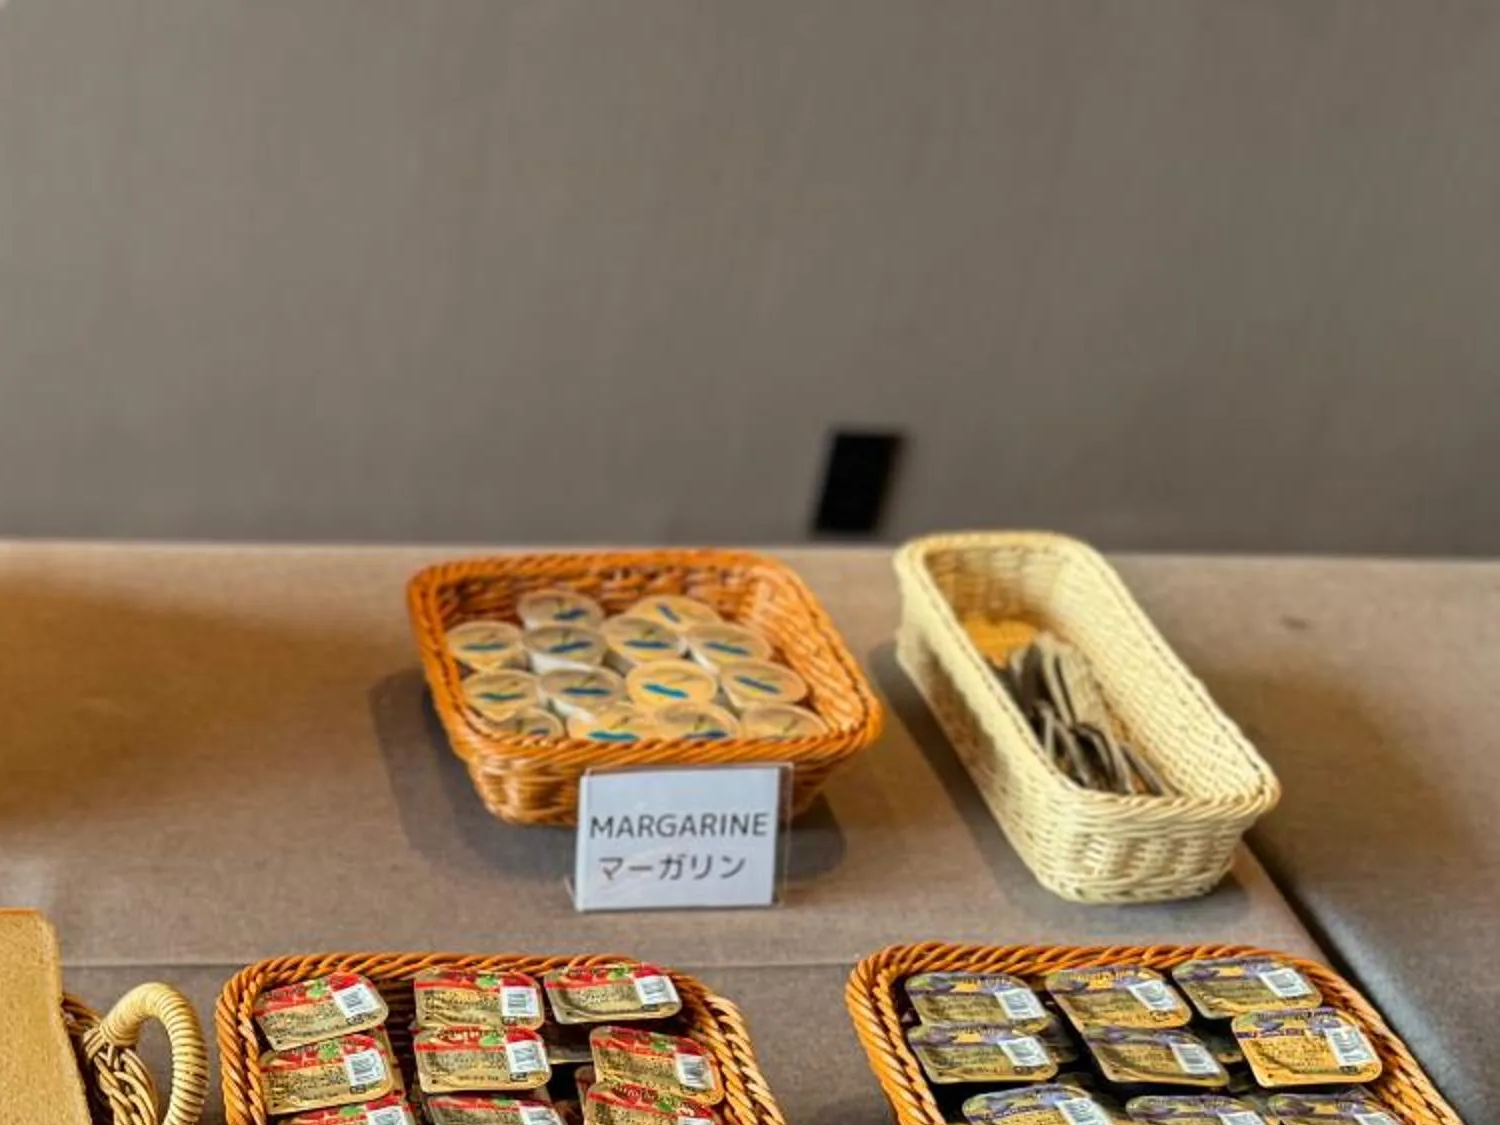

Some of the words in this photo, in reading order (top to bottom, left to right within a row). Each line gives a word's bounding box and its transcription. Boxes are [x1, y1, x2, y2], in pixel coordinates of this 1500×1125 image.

[589, 812, 770, 839] MARGARINE
[598, 854, 747, 881] マーガリン
